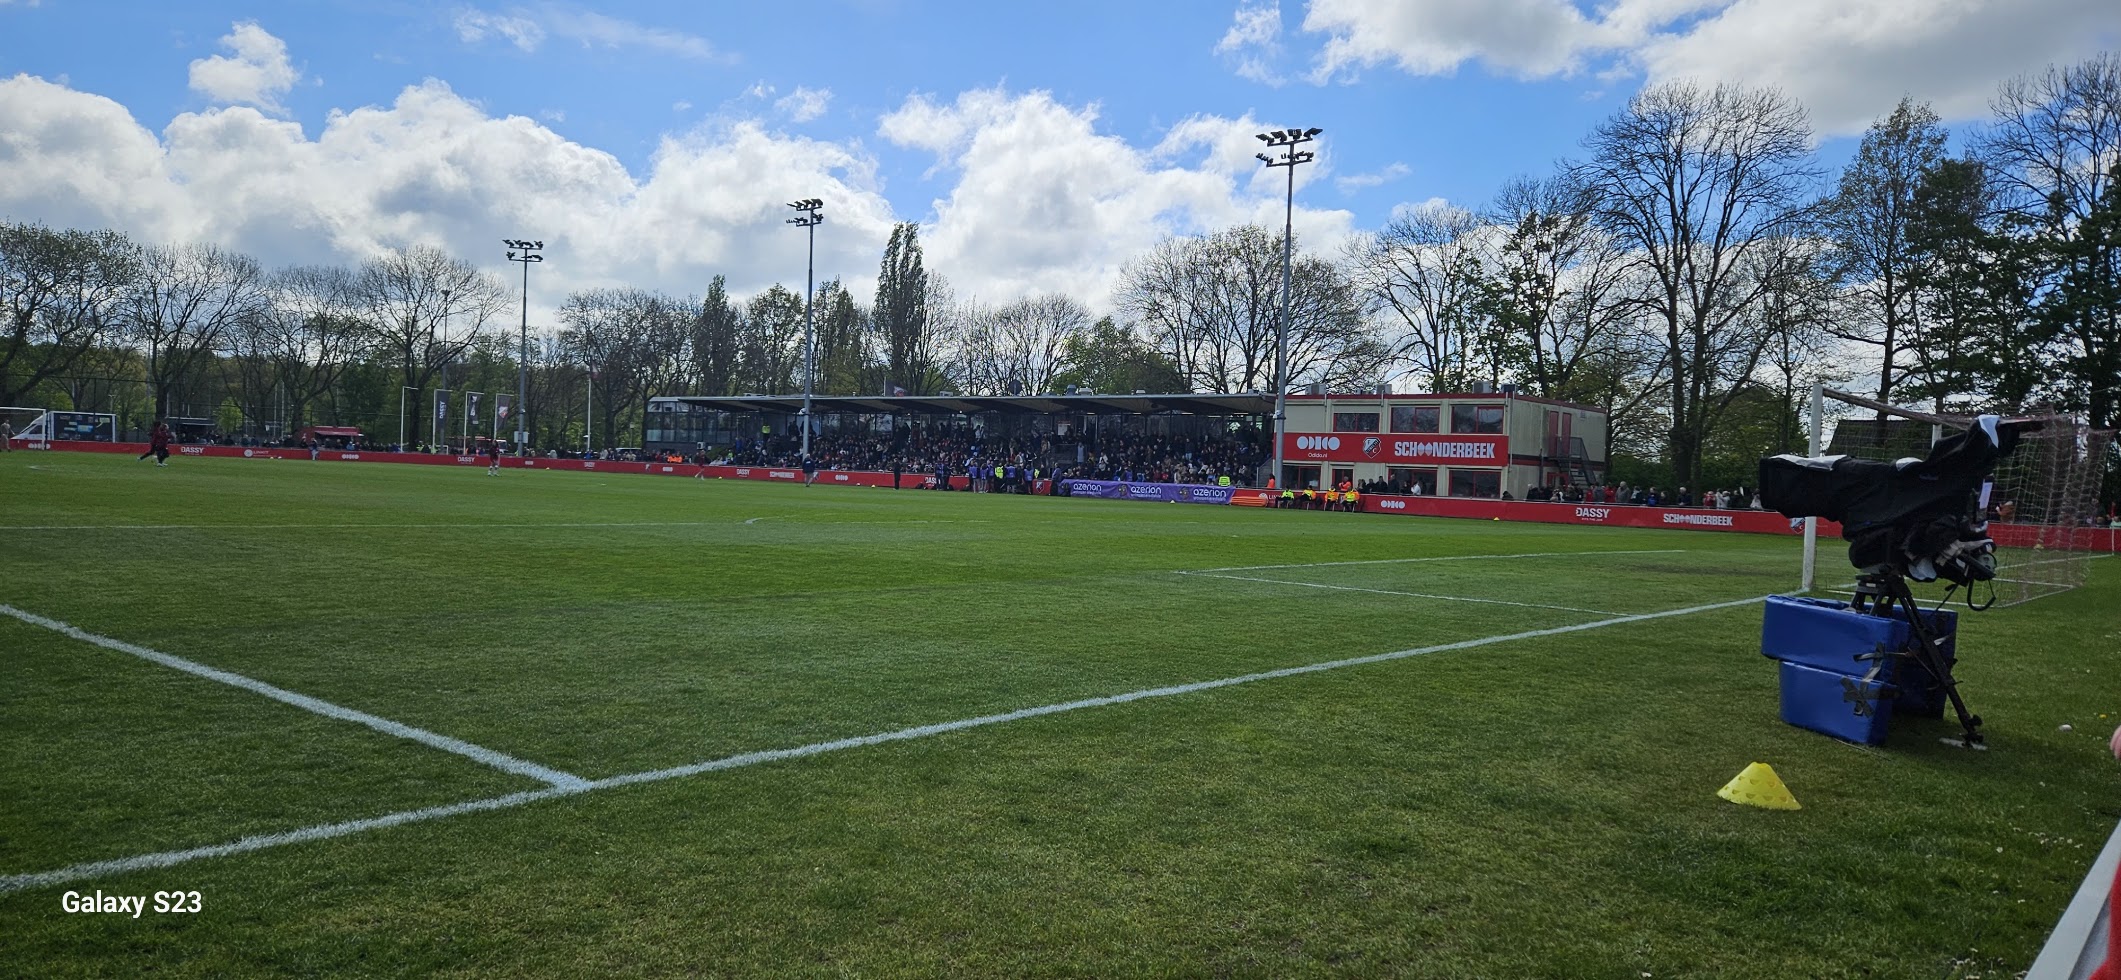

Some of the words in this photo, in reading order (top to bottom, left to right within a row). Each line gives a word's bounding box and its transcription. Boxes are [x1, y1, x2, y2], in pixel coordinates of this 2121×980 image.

[1073, 483, 1102, 492] azerion
[1130, 485, 1162, 495] azerion
[1193, 488, 1227, 498] azerion
[1575, 507, 1610, 519] DASSY
